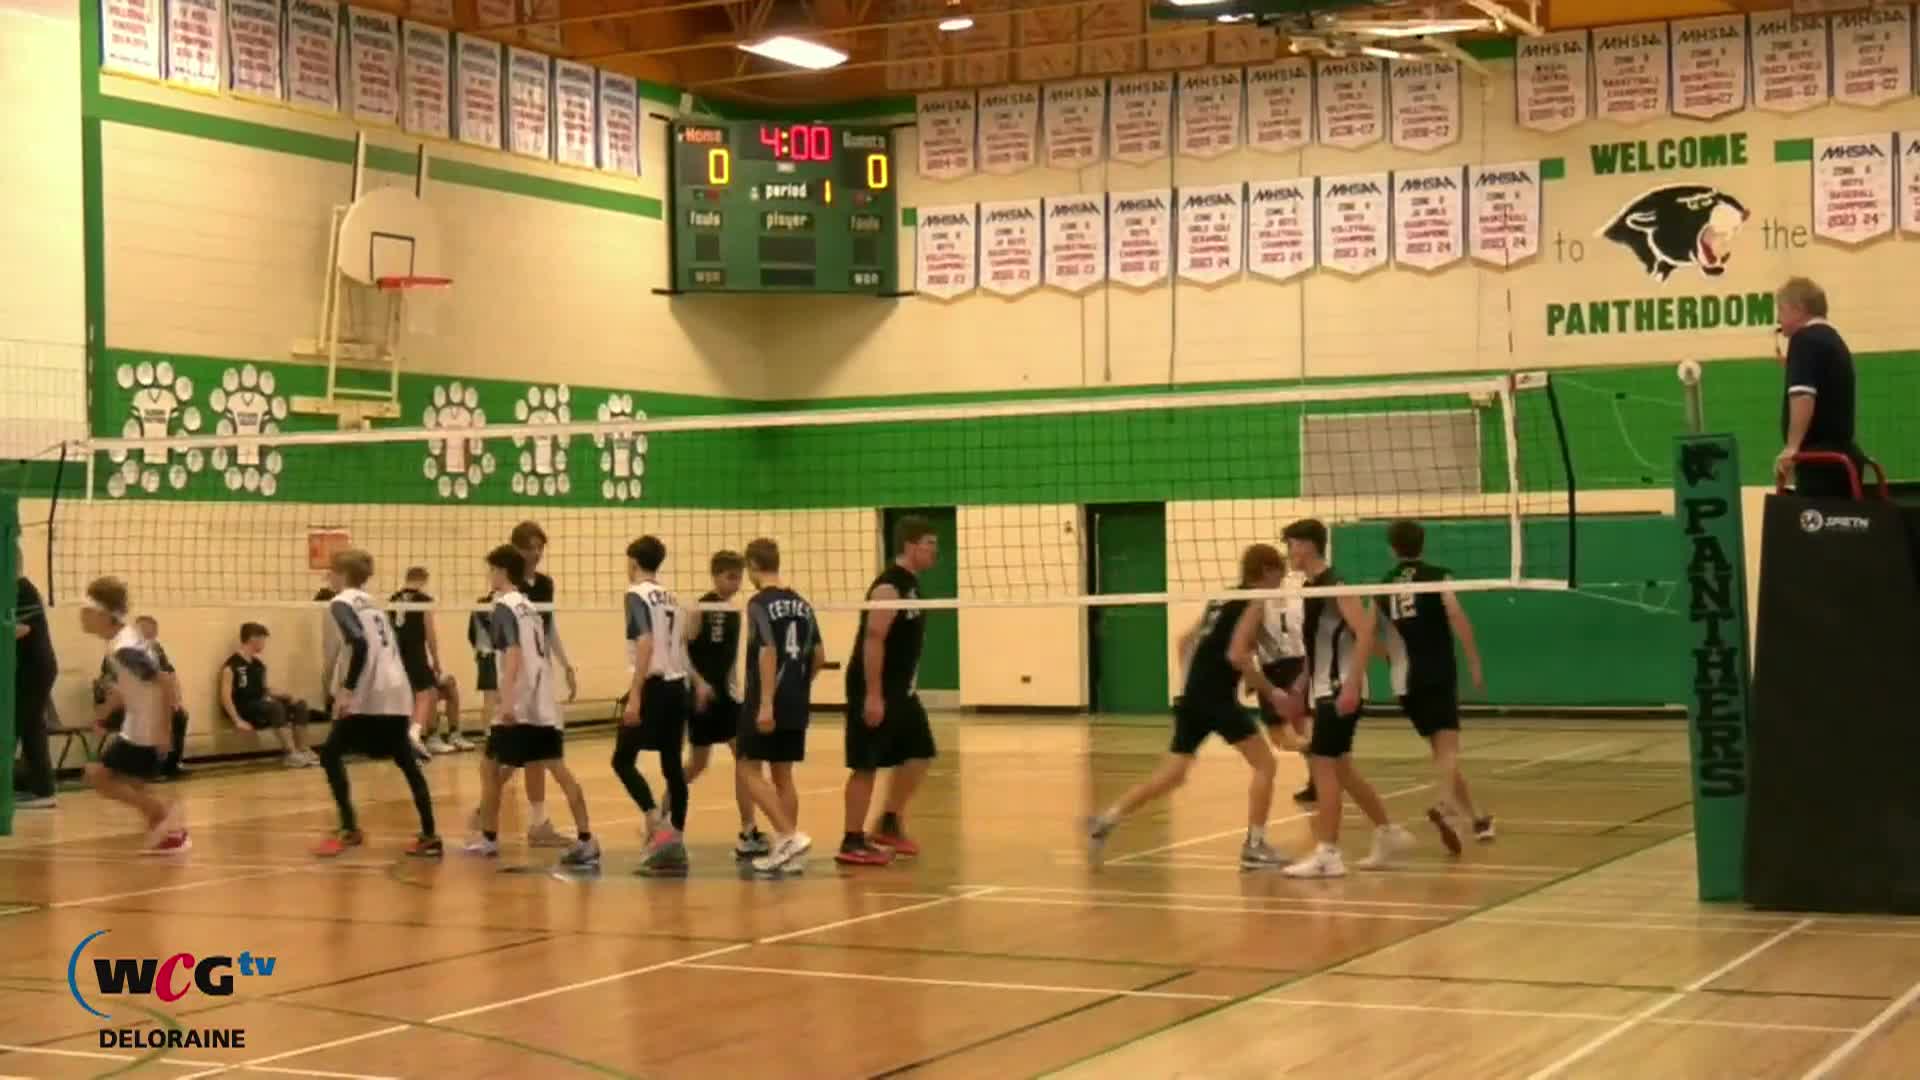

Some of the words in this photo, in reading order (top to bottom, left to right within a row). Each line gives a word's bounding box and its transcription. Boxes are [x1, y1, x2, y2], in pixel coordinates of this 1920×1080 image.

[1838, 9, 1905, 29] MHSAA
[1599, 33, 1662, 50] MHSAA
[1677, 27, 1740, 45] MHSAA
[1520, 40, 1584, 57] MHSAA
[1250, 67, 1308, 83] MHSAA
[1320, 61, 1378, 78] MHSAA
[1393, 63, 1455, 78] MHSAA
[761, 125, 831, 162] 4:00
[1590, 132, 1749, 175] WELCOME
[1820, 144, 1885, 162] MHSAA
[709, 148, 729, 186] 0
[867, 154, 887, 189] 0
[1400, 176, 1456, 192] MHSAA
[1474, 171, 1533, 188] MHSAA
[766, 183, 807, 201] period
[1253, 187, 1304, 204] MHSAA
[1326, 182, 1382, 198] MHSAA
[1114, 197, 1165, 213] MHSAA
[1183, 192, 1237, 210] MHSAA
[985, 208, 1033, 224] MHSAA
[1050, 202, 1101, 218] MHSAA
[766, 212, 808, 231] player
[921, 213, 970, 228] MHSAA
[1553, 233, 1586, 263] to
[1761, 223, 1808, 249] the
[1547, 292, 1775, 336] PANTHERDOM
[784, 620, 800, 660] 4
[1684, 497, 1745, 799] PANTHERS
